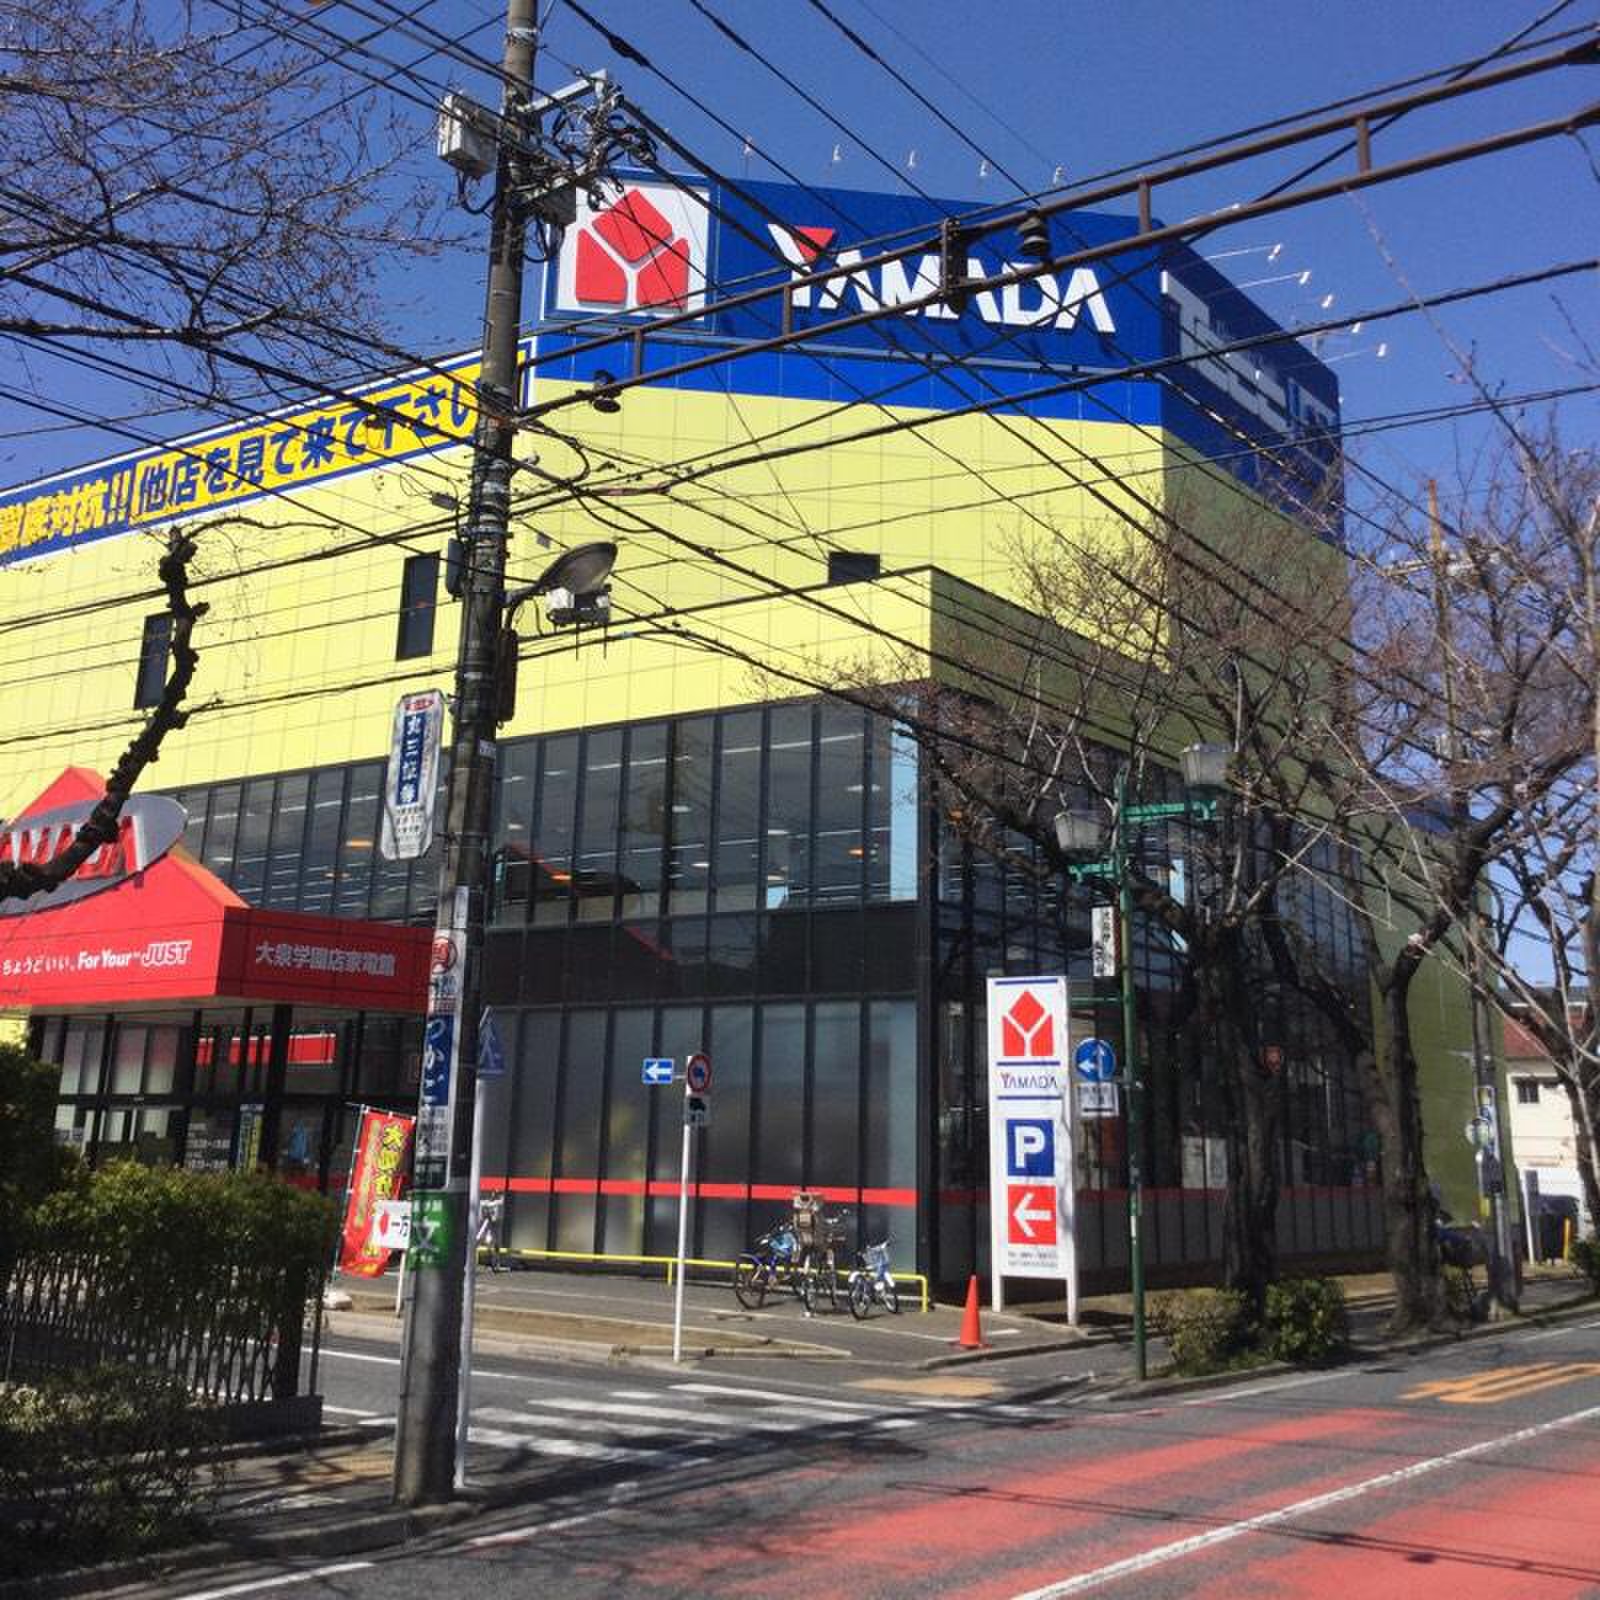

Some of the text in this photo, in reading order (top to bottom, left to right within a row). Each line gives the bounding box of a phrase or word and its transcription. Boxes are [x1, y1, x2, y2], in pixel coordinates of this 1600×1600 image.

[767, 222, 1116, 333] YAMADA
[77, 950, 99, 971] For
[1000, 1072, 1058, 1089] YAMADA
[1014, 1125, 1045, 1168] P
